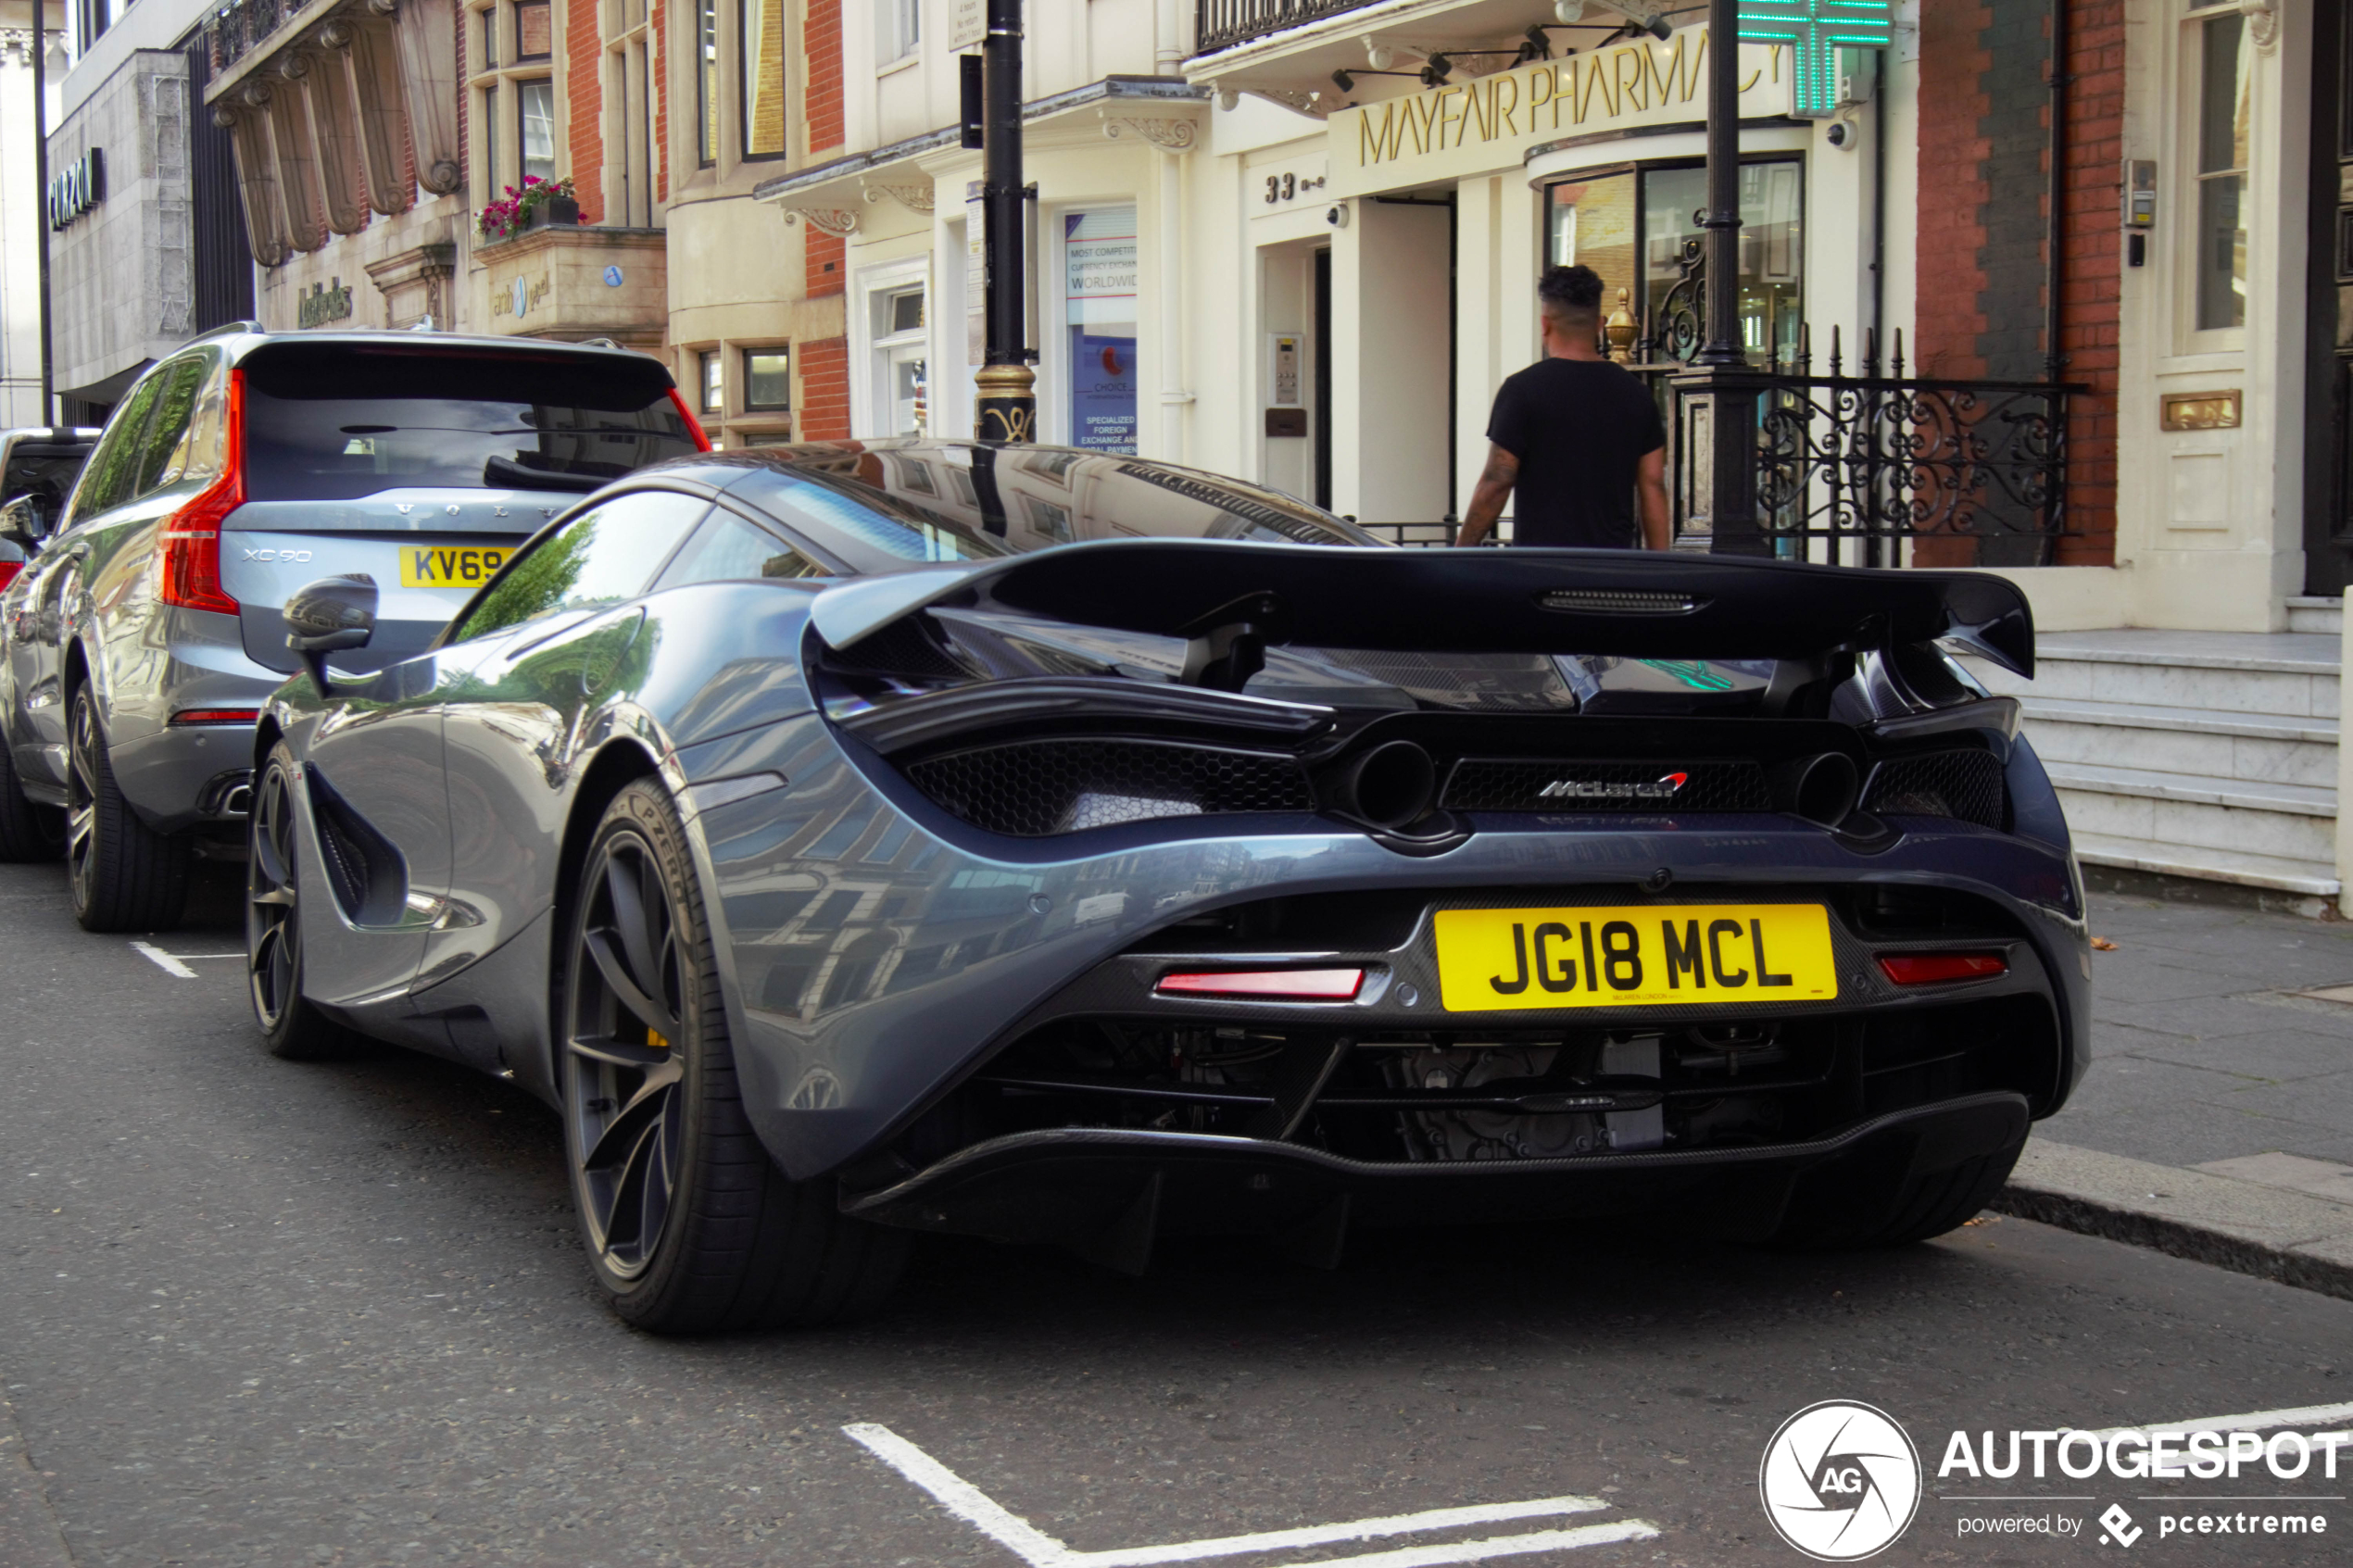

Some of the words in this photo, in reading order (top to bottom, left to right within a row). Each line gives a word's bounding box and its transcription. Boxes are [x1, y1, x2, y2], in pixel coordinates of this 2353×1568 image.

[1360, 75, 1517, 167] MAYFAIR
[48, 147, 103, 232] CURZON
[1265, 172, 1294, 204] 33
[1071, 248, 1092, 257] MOST
[1071, 262, 1107, 271] CURRENCY
[1095, 383, 1127, 392] CHOICE
[1087, 416, 1135, 424] SPECIALIZED
[1081, 436, 1123, 445] EXCHANGE
[415, 551, 502, 580] KV69
[1539, 780, 1673, 797] McLaren
[642, 807, 655, 819] P
[652, 821, 686, 905] ZERO
[1490, 921, 1643, 995] JG18
[1662, 918, 1793, 990] MCL
